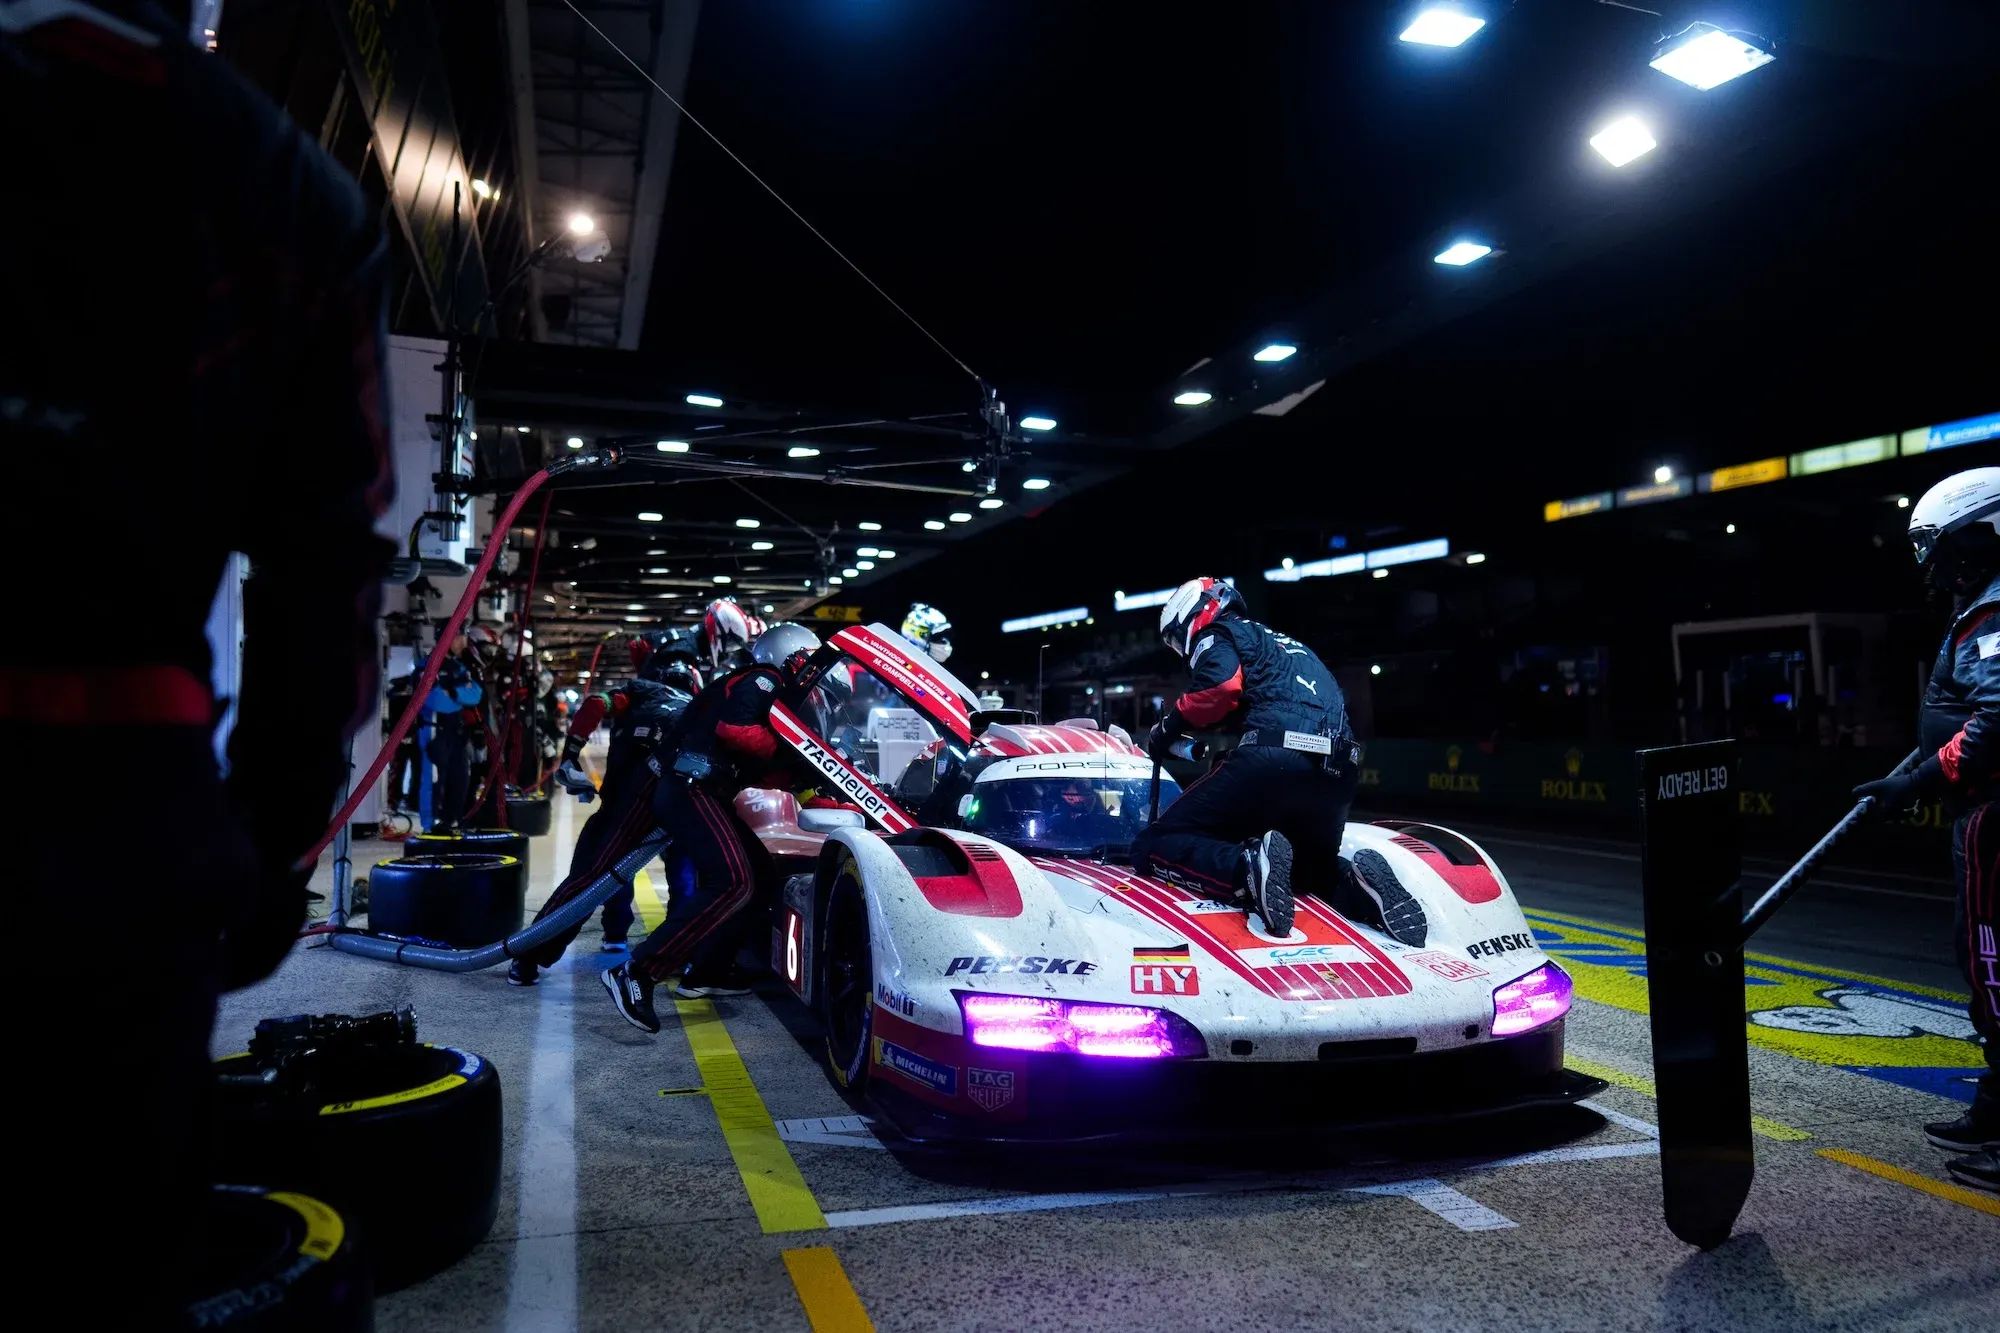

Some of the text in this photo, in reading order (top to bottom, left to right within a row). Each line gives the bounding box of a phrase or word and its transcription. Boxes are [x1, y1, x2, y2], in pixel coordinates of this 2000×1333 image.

[870, 639, 906, 666] VANTHOOR
[881, 664, 916, 691] CAMPBELL
[1428, 772, 1480, 793] ROLEX
[1540, 778, 1607, 801] ROLEX
[1657, 765, 1728, 801] GET READY
[786, 913, 798, 981] 6
[1270, 947, 1334, 958] WEC
[1466, 933, 1534, 960] PENSKE
[1134, 967, 1193, 993] HY
[1429, 960, 1483, 979] CAR
[877, 983, 902, 1012] Mobil
[895, 1054, 948, 1086] MICHELIN
[971, 1070, 1011, 1088] TAG
[968, 1086, 1012, 1109] HEUER
